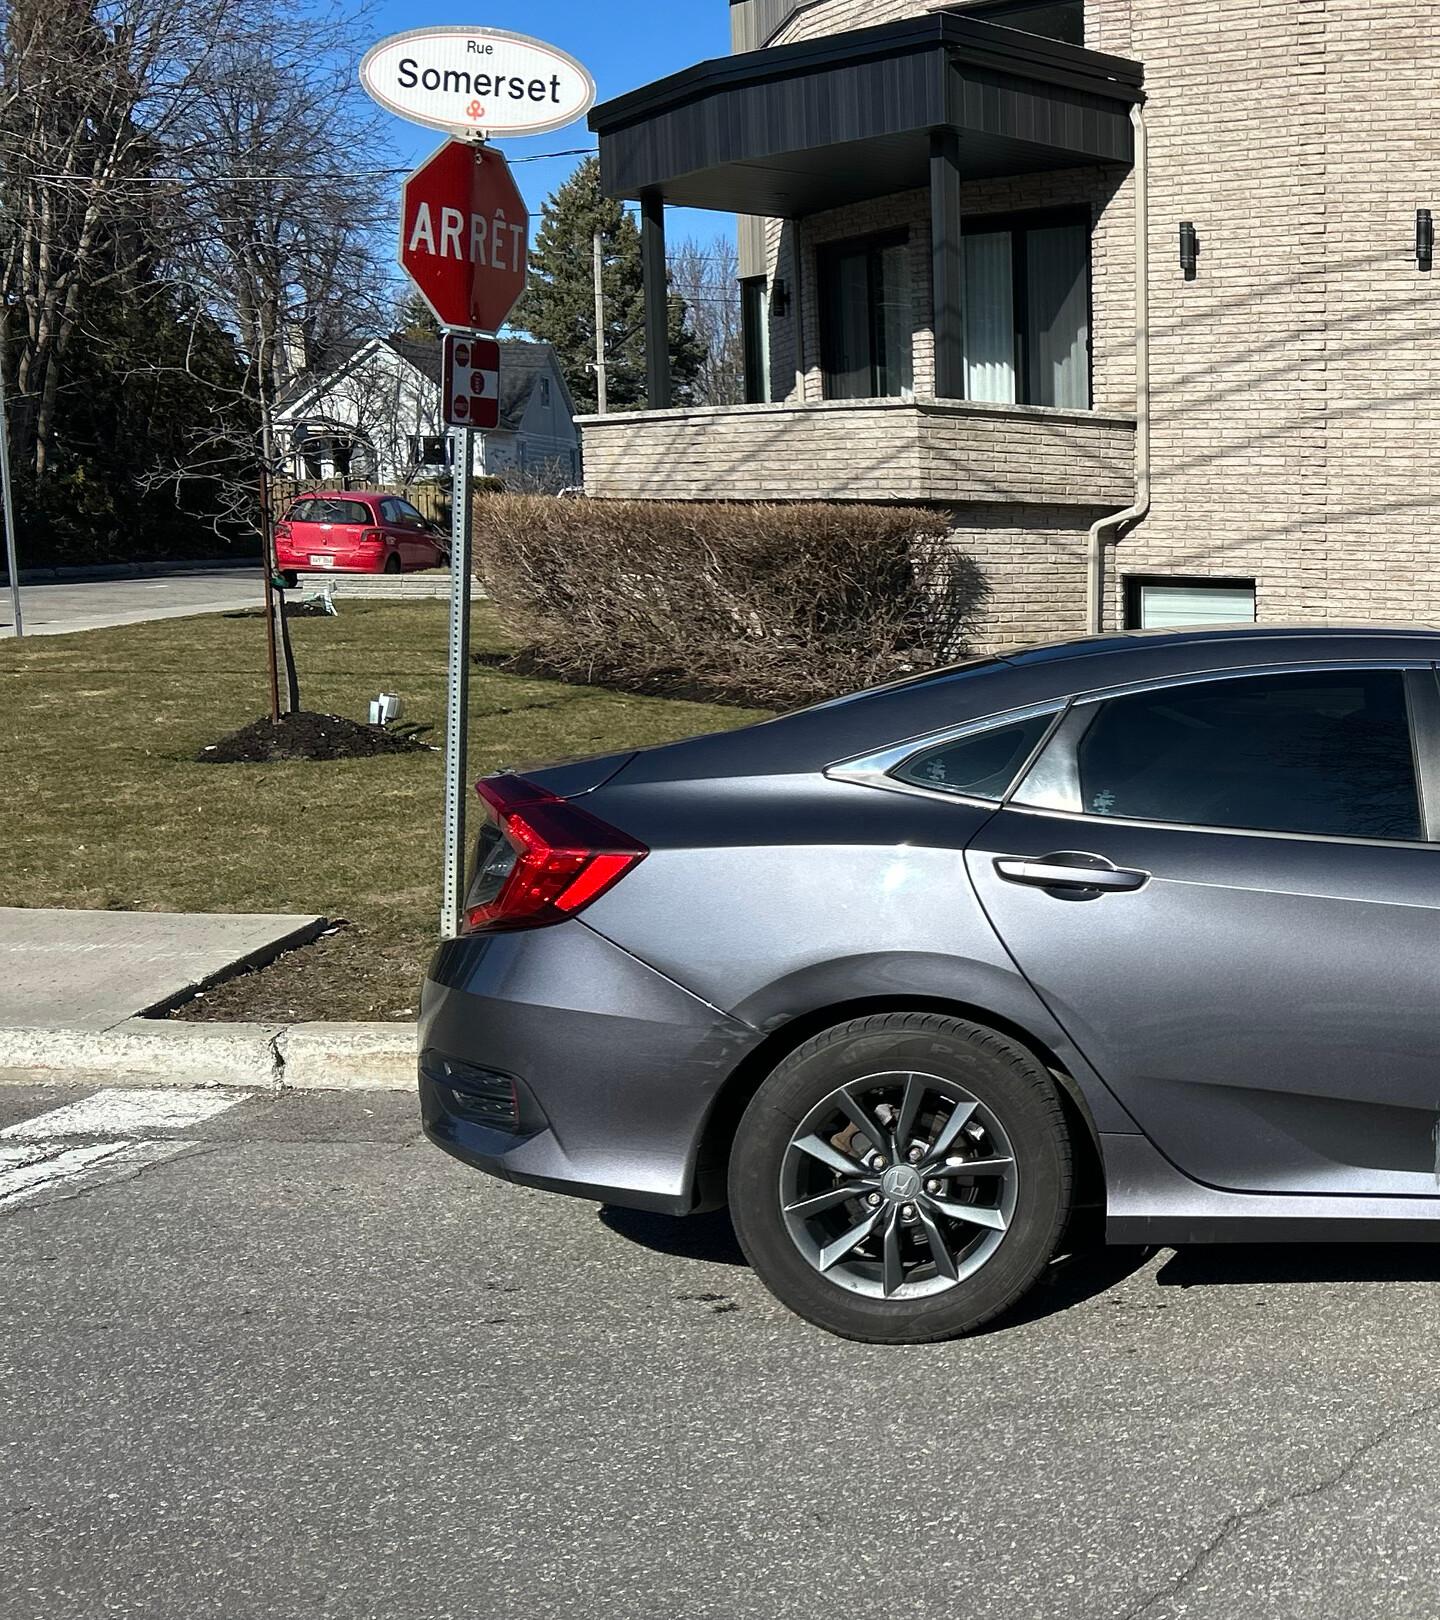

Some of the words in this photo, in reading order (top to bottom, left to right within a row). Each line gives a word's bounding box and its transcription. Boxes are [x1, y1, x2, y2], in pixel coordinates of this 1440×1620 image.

[466, 40, 493, 55] Rue
[397, 58, 560, 103] Somerset
[409, 202, 524, 273] ARRÊT
